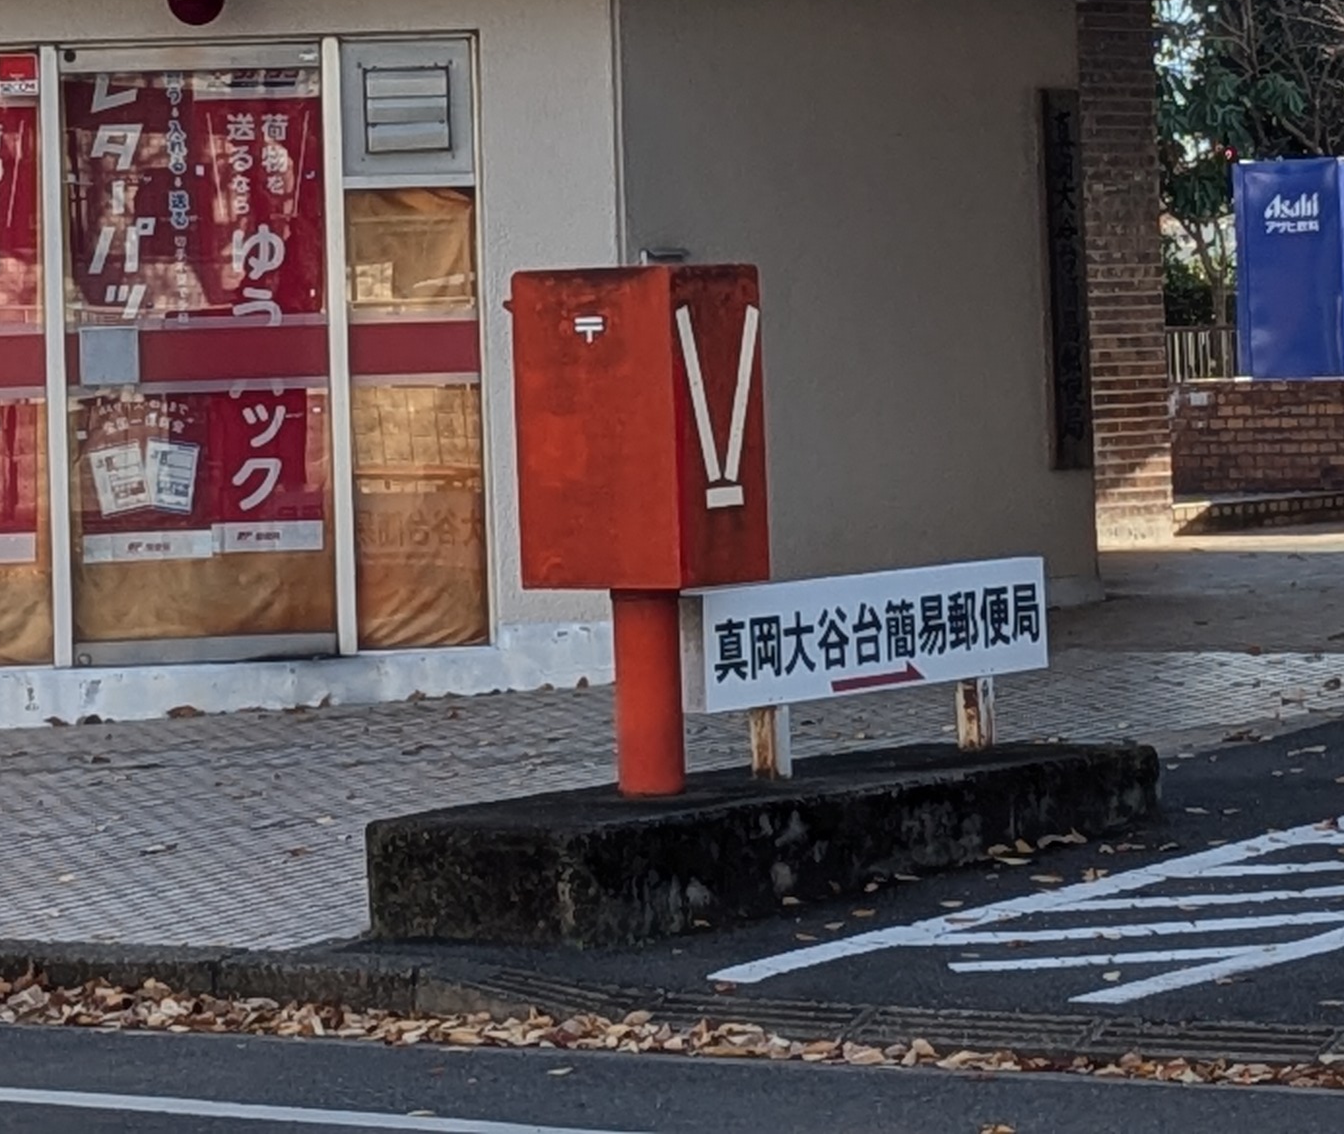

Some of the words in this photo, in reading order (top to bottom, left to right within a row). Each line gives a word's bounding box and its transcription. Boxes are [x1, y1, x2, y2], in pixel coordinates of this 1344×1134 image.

[226, 114, 256, 214] 送るなら
[262, 114, 289, 194] 荷物を
[1264, 192, 1319, 219] Asahi
[714, 583, 1040, 683] 真岡大谷台簡易郵便局
